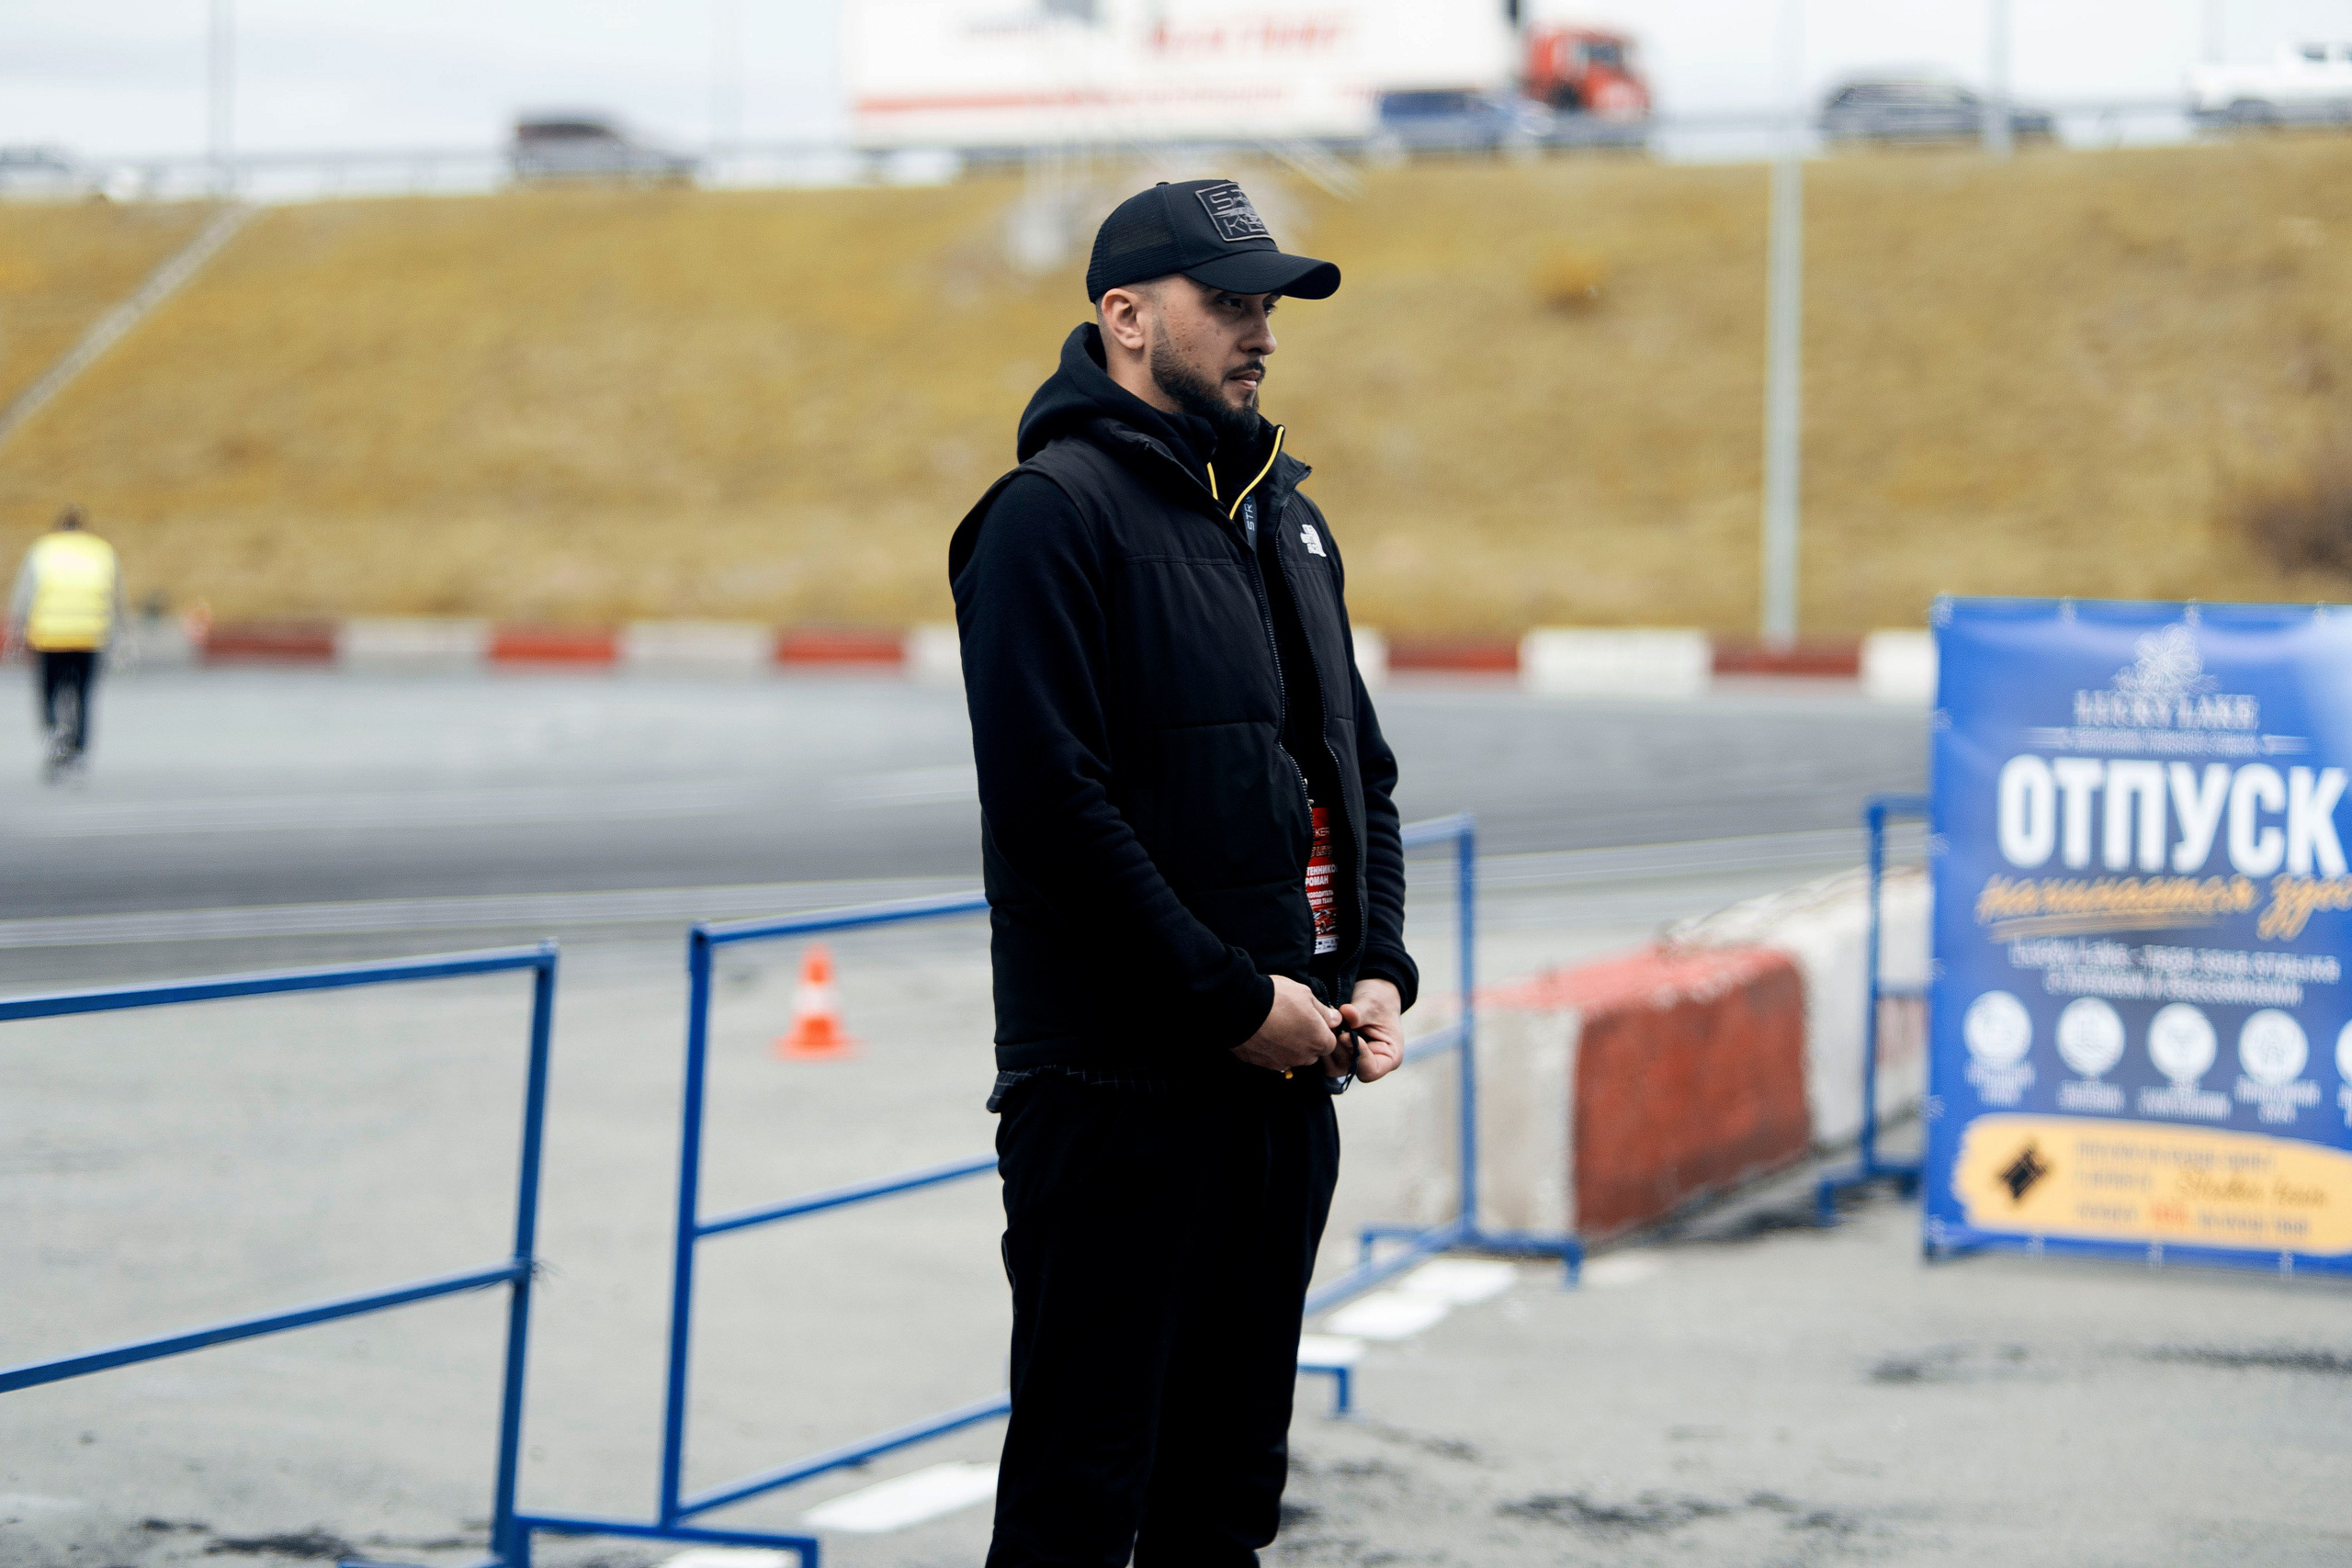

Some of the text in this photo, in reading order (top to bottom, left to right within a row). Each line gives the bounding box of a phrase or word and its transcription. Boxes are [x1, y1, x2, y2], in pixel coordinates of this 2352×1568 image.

[1996, 753, 2350, 877] ОТПУСК
[1315, 827, 1330, 837] KER
[1305, 875, 1328, 886] РОМАН
